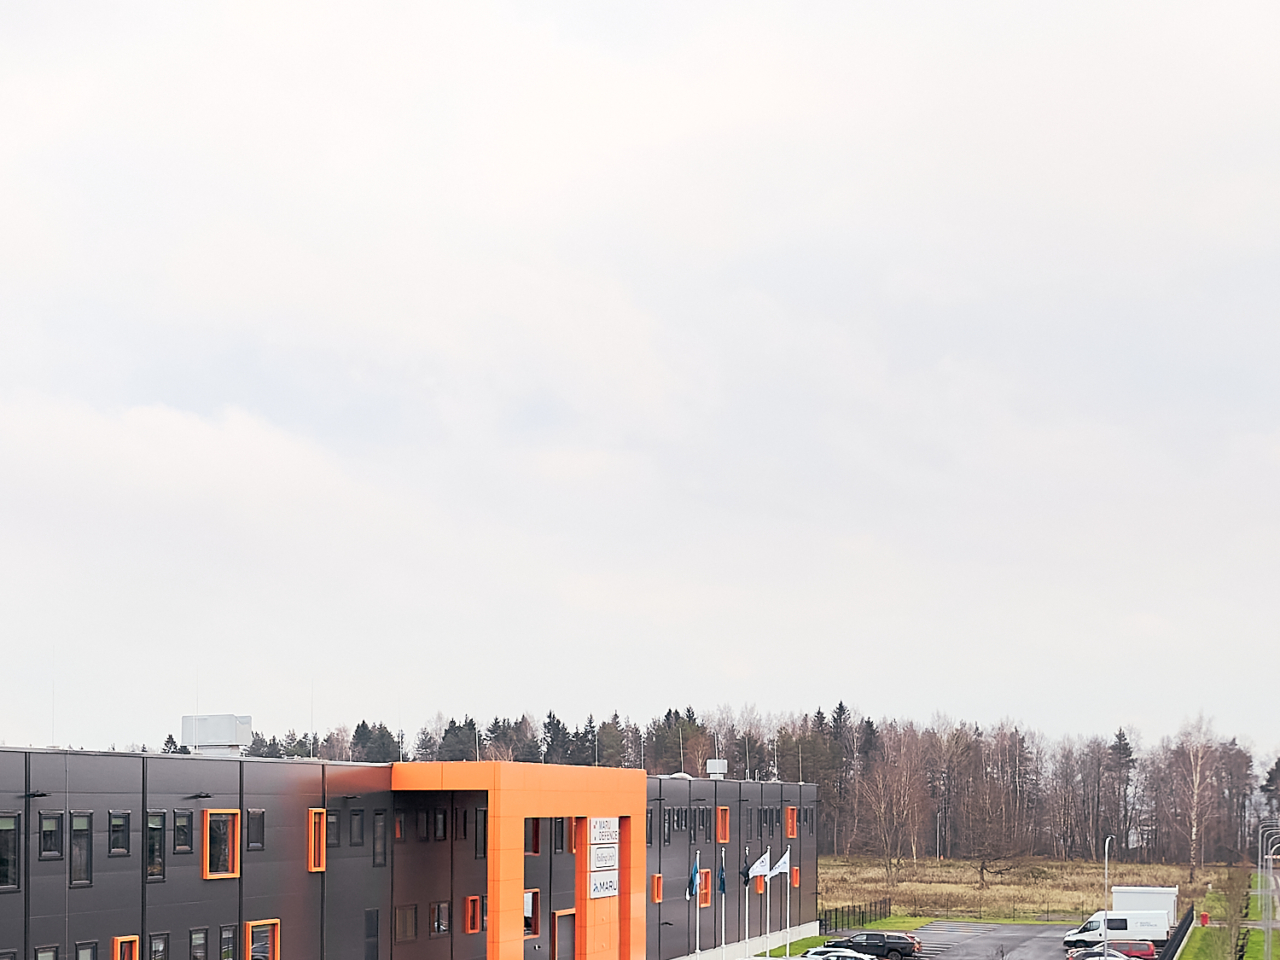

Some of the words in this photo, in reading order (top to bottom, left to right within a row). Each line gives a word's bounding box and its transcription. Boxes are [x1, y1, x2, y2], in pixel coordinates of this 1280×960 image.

[598, 820, 611, 830] MARU
[598, 830, 618, 841] DEFENCE
[599, 880, 617, 892] MARU
